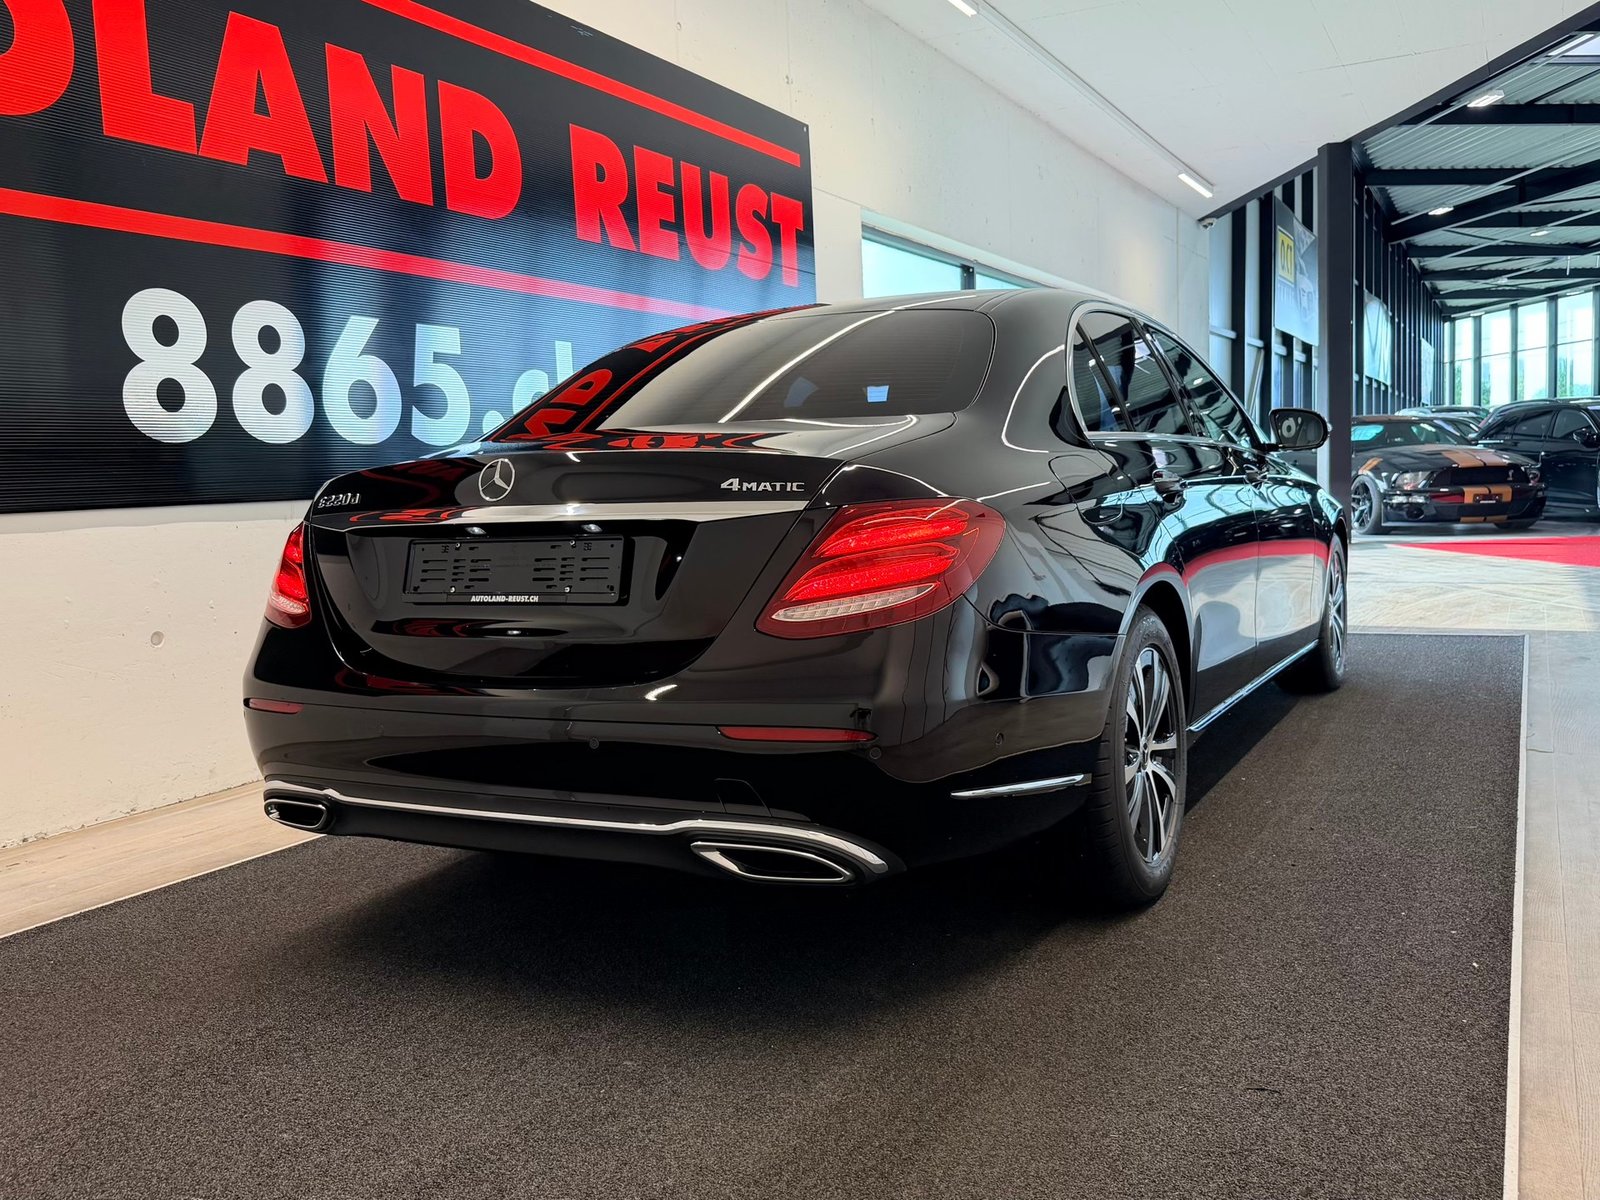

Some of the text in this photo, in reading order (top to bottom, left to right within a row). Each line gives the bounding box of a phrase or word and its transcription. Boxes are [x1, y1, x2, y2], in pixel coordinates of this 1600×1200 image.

[569, 123, 804, 287] REUST
[122, 287, 574, 445] 8865.c
[720, 478, 805, 492] 4MATIC
[470, 595, 539, 603] AUTOLAND-REUST.CH
